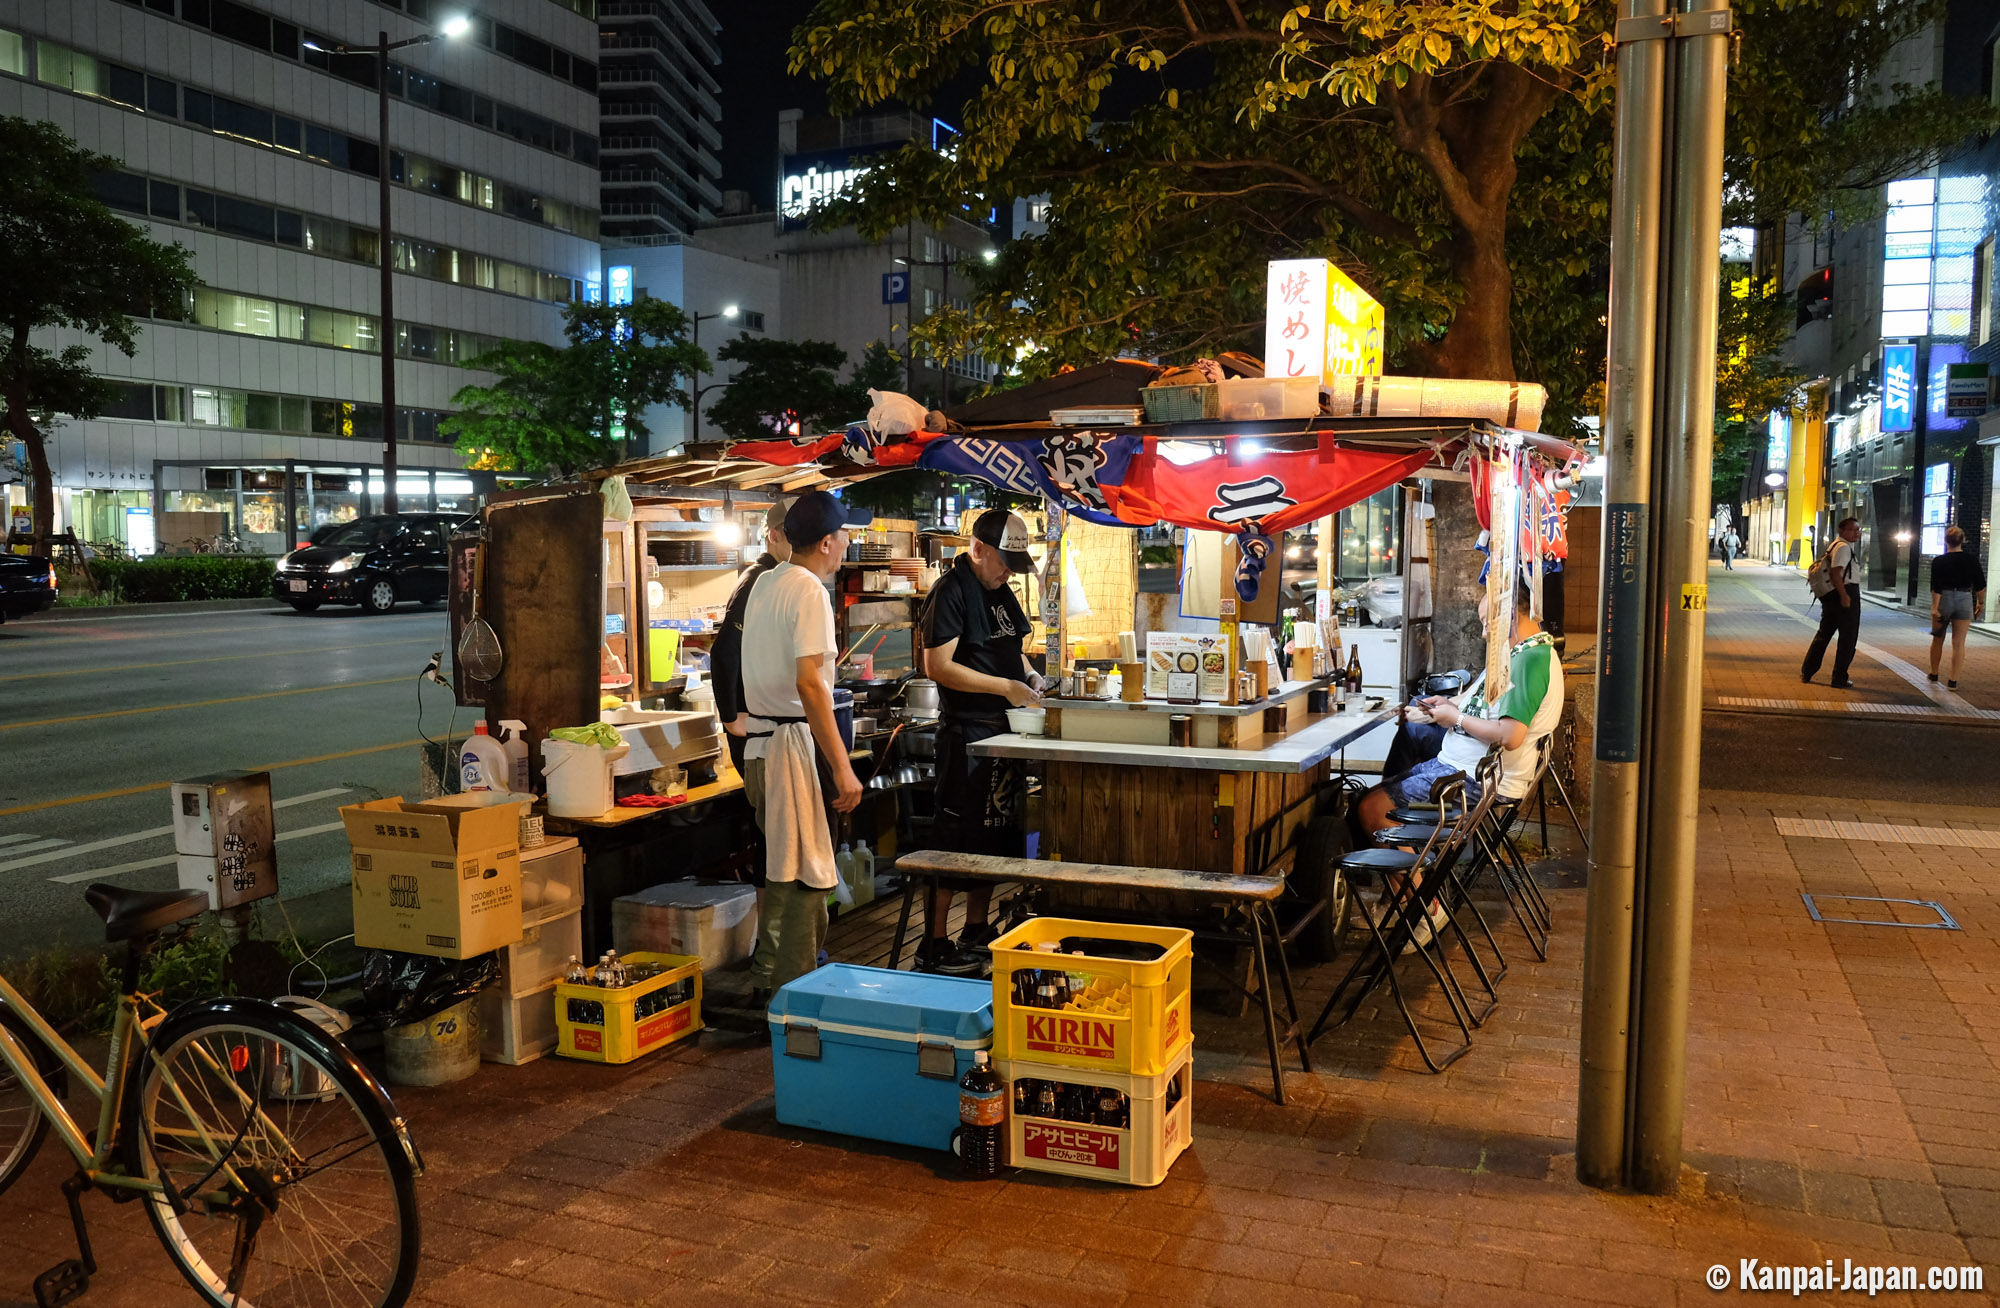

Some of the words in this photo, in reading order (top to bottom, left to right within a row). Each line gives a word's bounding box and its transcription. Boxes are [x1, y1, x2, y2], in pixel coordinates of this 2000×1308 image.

[888, 276, 904, 300] P
[1280, 271, 1311, 377] 焼めし
[14, 517, 31, 532] P
[388, 874, 419, 893] CLUB
[390, 891, 421, 909] SODA
[437, 1017, 457, 1036] 76
[1026, 1015, 1115, 1049] KIRIN
[1053, 1045, 1087, 1055] キリンビール
[1026, 1125, 1118, 1153] アサヒビール
